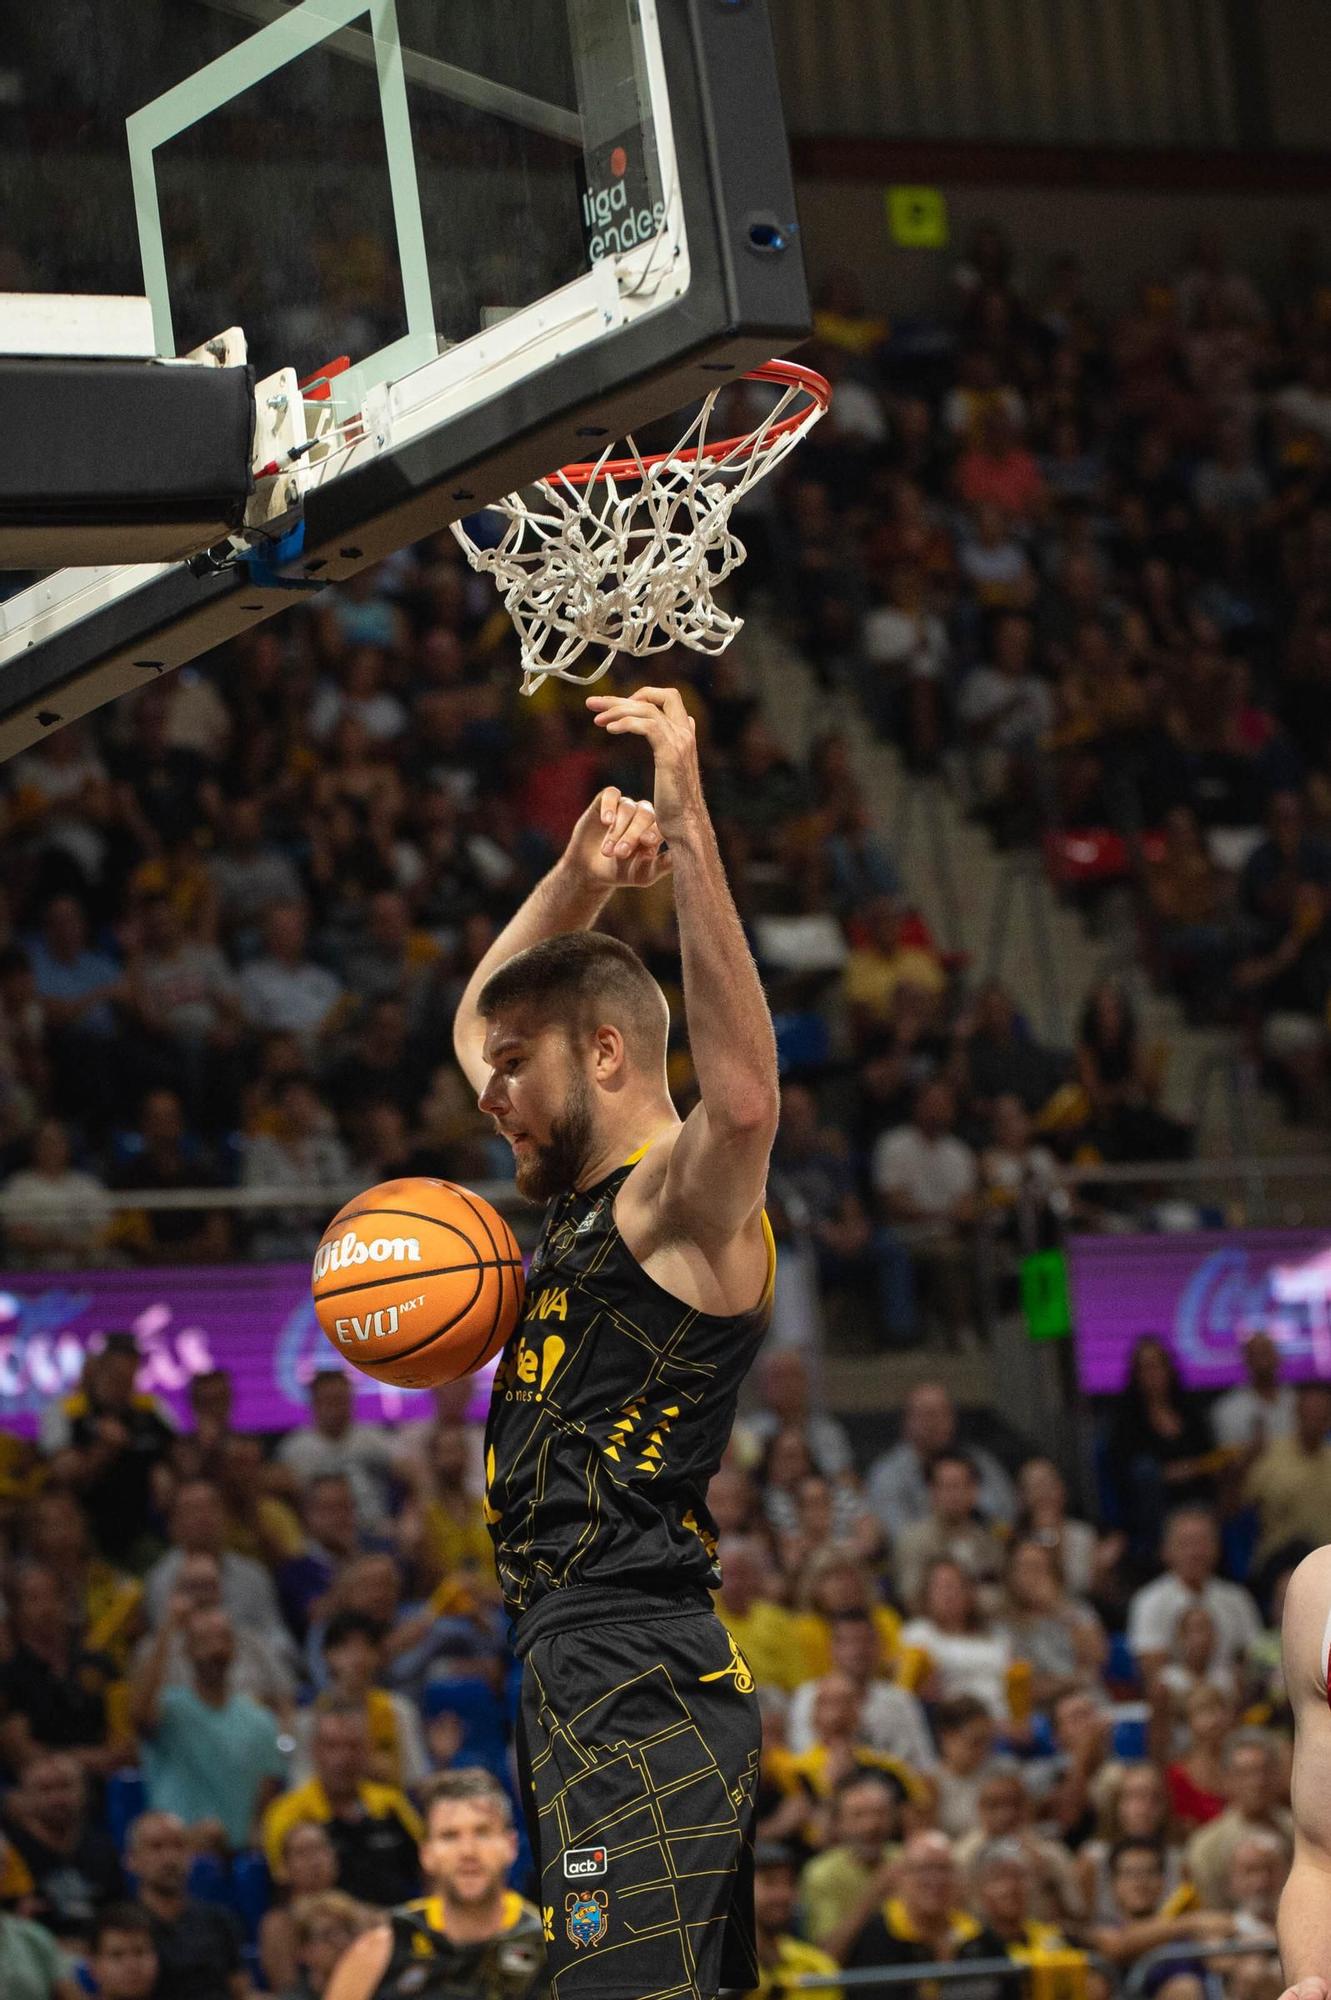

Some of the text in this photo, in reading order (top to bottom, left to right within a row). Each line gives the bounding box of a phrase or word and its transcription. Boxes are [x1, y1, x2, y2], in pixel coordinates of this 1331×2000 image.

[583, 180, 627, 228] liga
[313, 1232, 421, 1282] Wilson
[399, 1294, 426, 1313] NXT
[568, 1859, 598, 1874] acb
